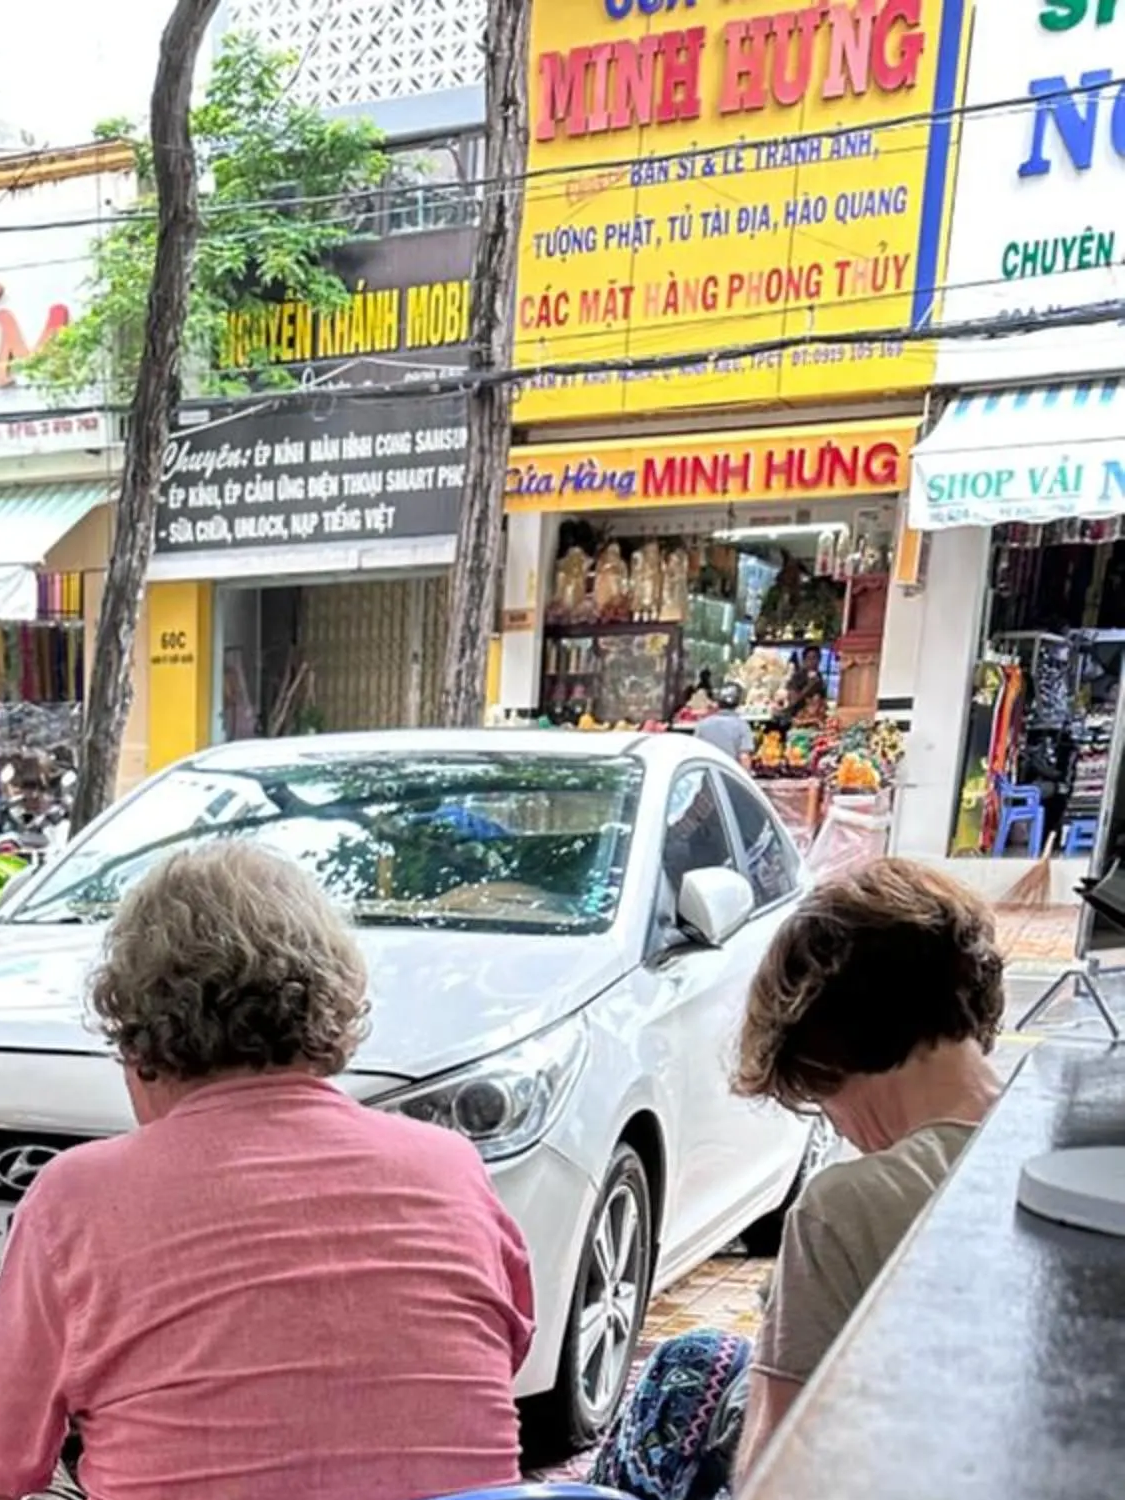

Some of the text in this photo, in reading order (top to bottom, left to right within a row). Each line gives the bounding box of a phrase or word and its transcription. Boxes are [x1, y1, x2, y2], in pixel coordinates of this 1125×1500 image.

[535, 26, 706, 142] MINH
[702, 156, 717, 177] &
[533, 229, 597, 263] TƯỢNG
[668, 204, 693, 241] TỦ
[701, 205, 731, 238] TÀI
[784, 192, 827, 229] HÀO
[834, 186, 909, 221] QUANG
[1001, 226, 1115, 280] CHUYÊN
[520, 284, 569, 330] CÁC
[644, 269, 719, 317] HÀNG
[726, 262, 824, 309] PHONG
[835, 240, 912, 297] THỦY
[318, 279, 400, 357] KHÁNH
[254, 438, 272, 467] ÉP
[375, 430, 413, 456] CONG
[559, 458, 637, 498] Hàng
[642, 449, 751, 498] MINH
[764, 440, 900, 490] HƯNG
[168, 482, 186, 509] ÉP
[224, 478, 242, 505] ÉP
[385, 466, 436, 493] SMART
[927, 469, 1015, 503] SHOP
[1028, 454, 1084, 496] VẢI
